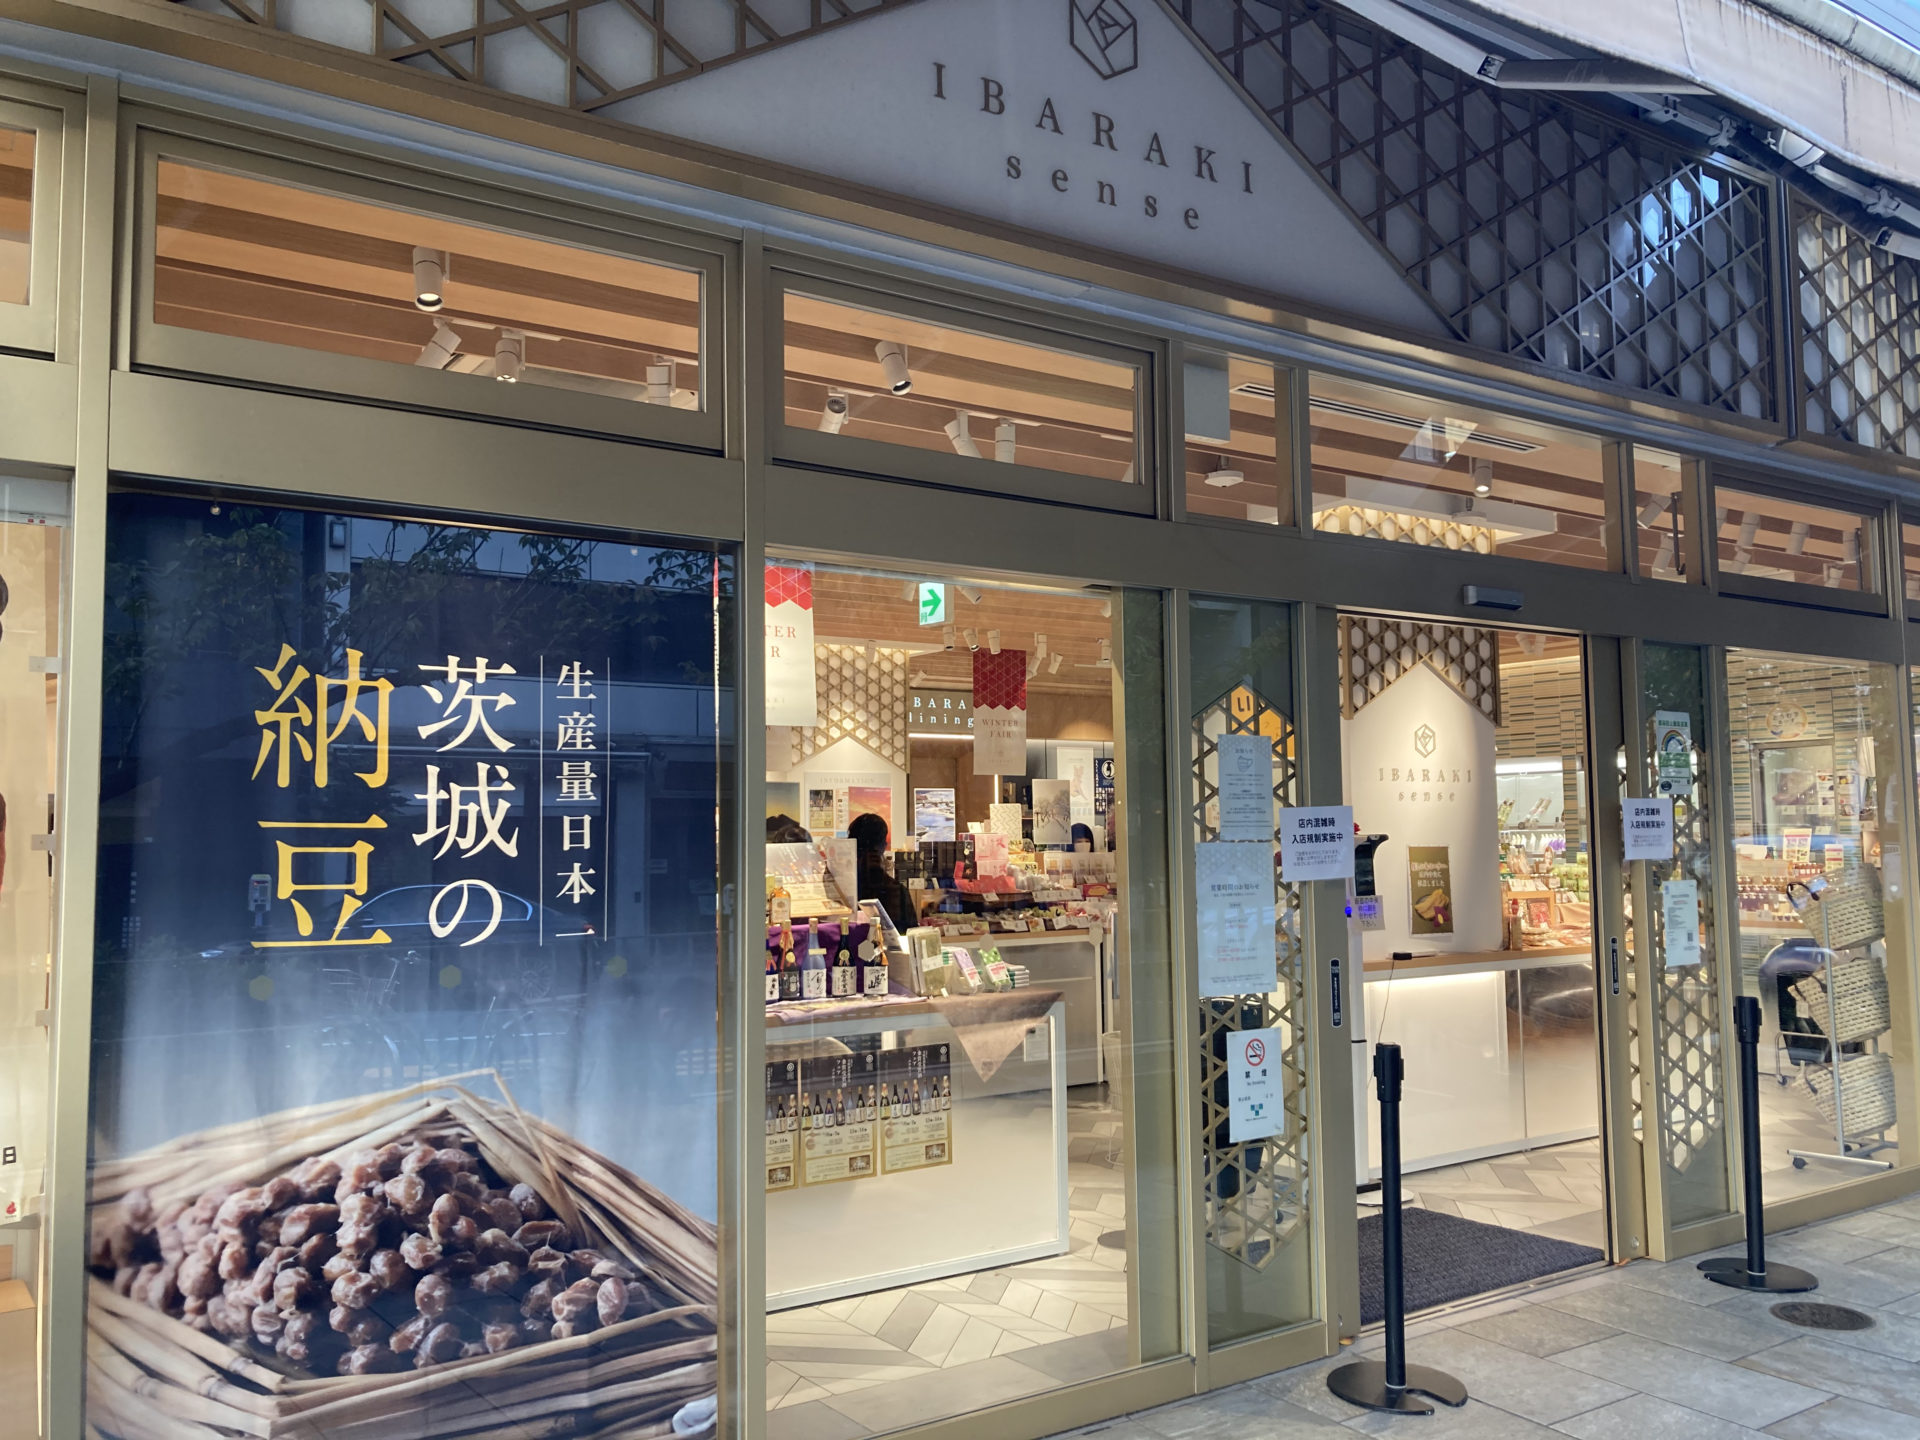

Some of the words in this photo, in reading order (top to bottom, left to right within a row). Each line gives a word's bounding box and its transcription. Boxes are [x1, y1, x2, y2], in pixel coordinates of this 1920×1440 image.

[933, 62, 1254, 194] IBARAKI
[1006, 155, 1200, 230] sense
[982, 719, 1018, 727] WINTER
[250, 643, 395, 948] 納豆
[1378, 767, 1472, 783] IBARAKI
[1398, 791, 1456, 802] sense
[411, 655, 519, 947] 茨城の
[556, 661, 596, 937] 生産量日本一
[1291, 832, 1344, 844] 入店規制実施中
[1298, 817, 1335, 829] 店内混雑時
